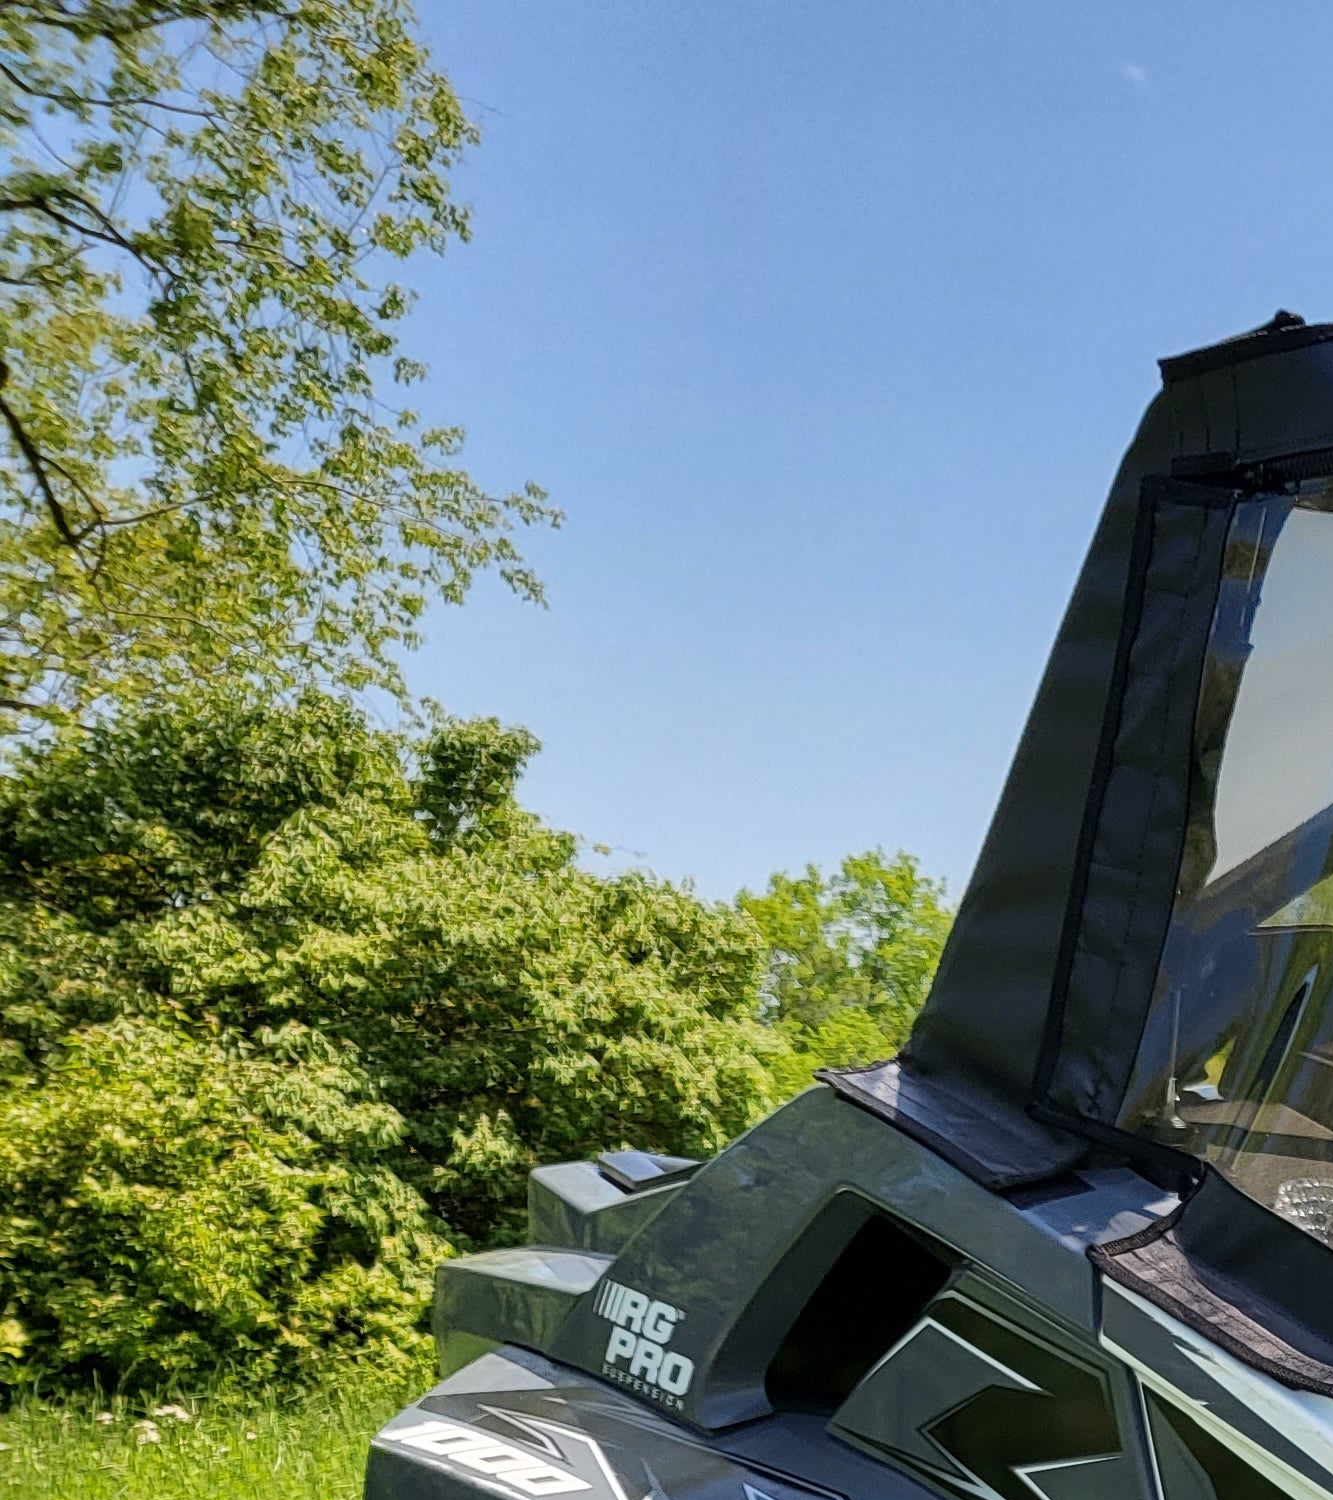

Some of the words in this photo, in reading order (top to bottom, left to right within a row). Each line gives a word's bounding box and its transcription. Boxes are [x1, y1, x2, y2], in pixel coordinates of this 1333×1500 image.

[601, 1362, 685, 1411] SUSPENSION
[604, 1325, 695, 1396] PRO
[378, 1420, 593, 1496] 1000
